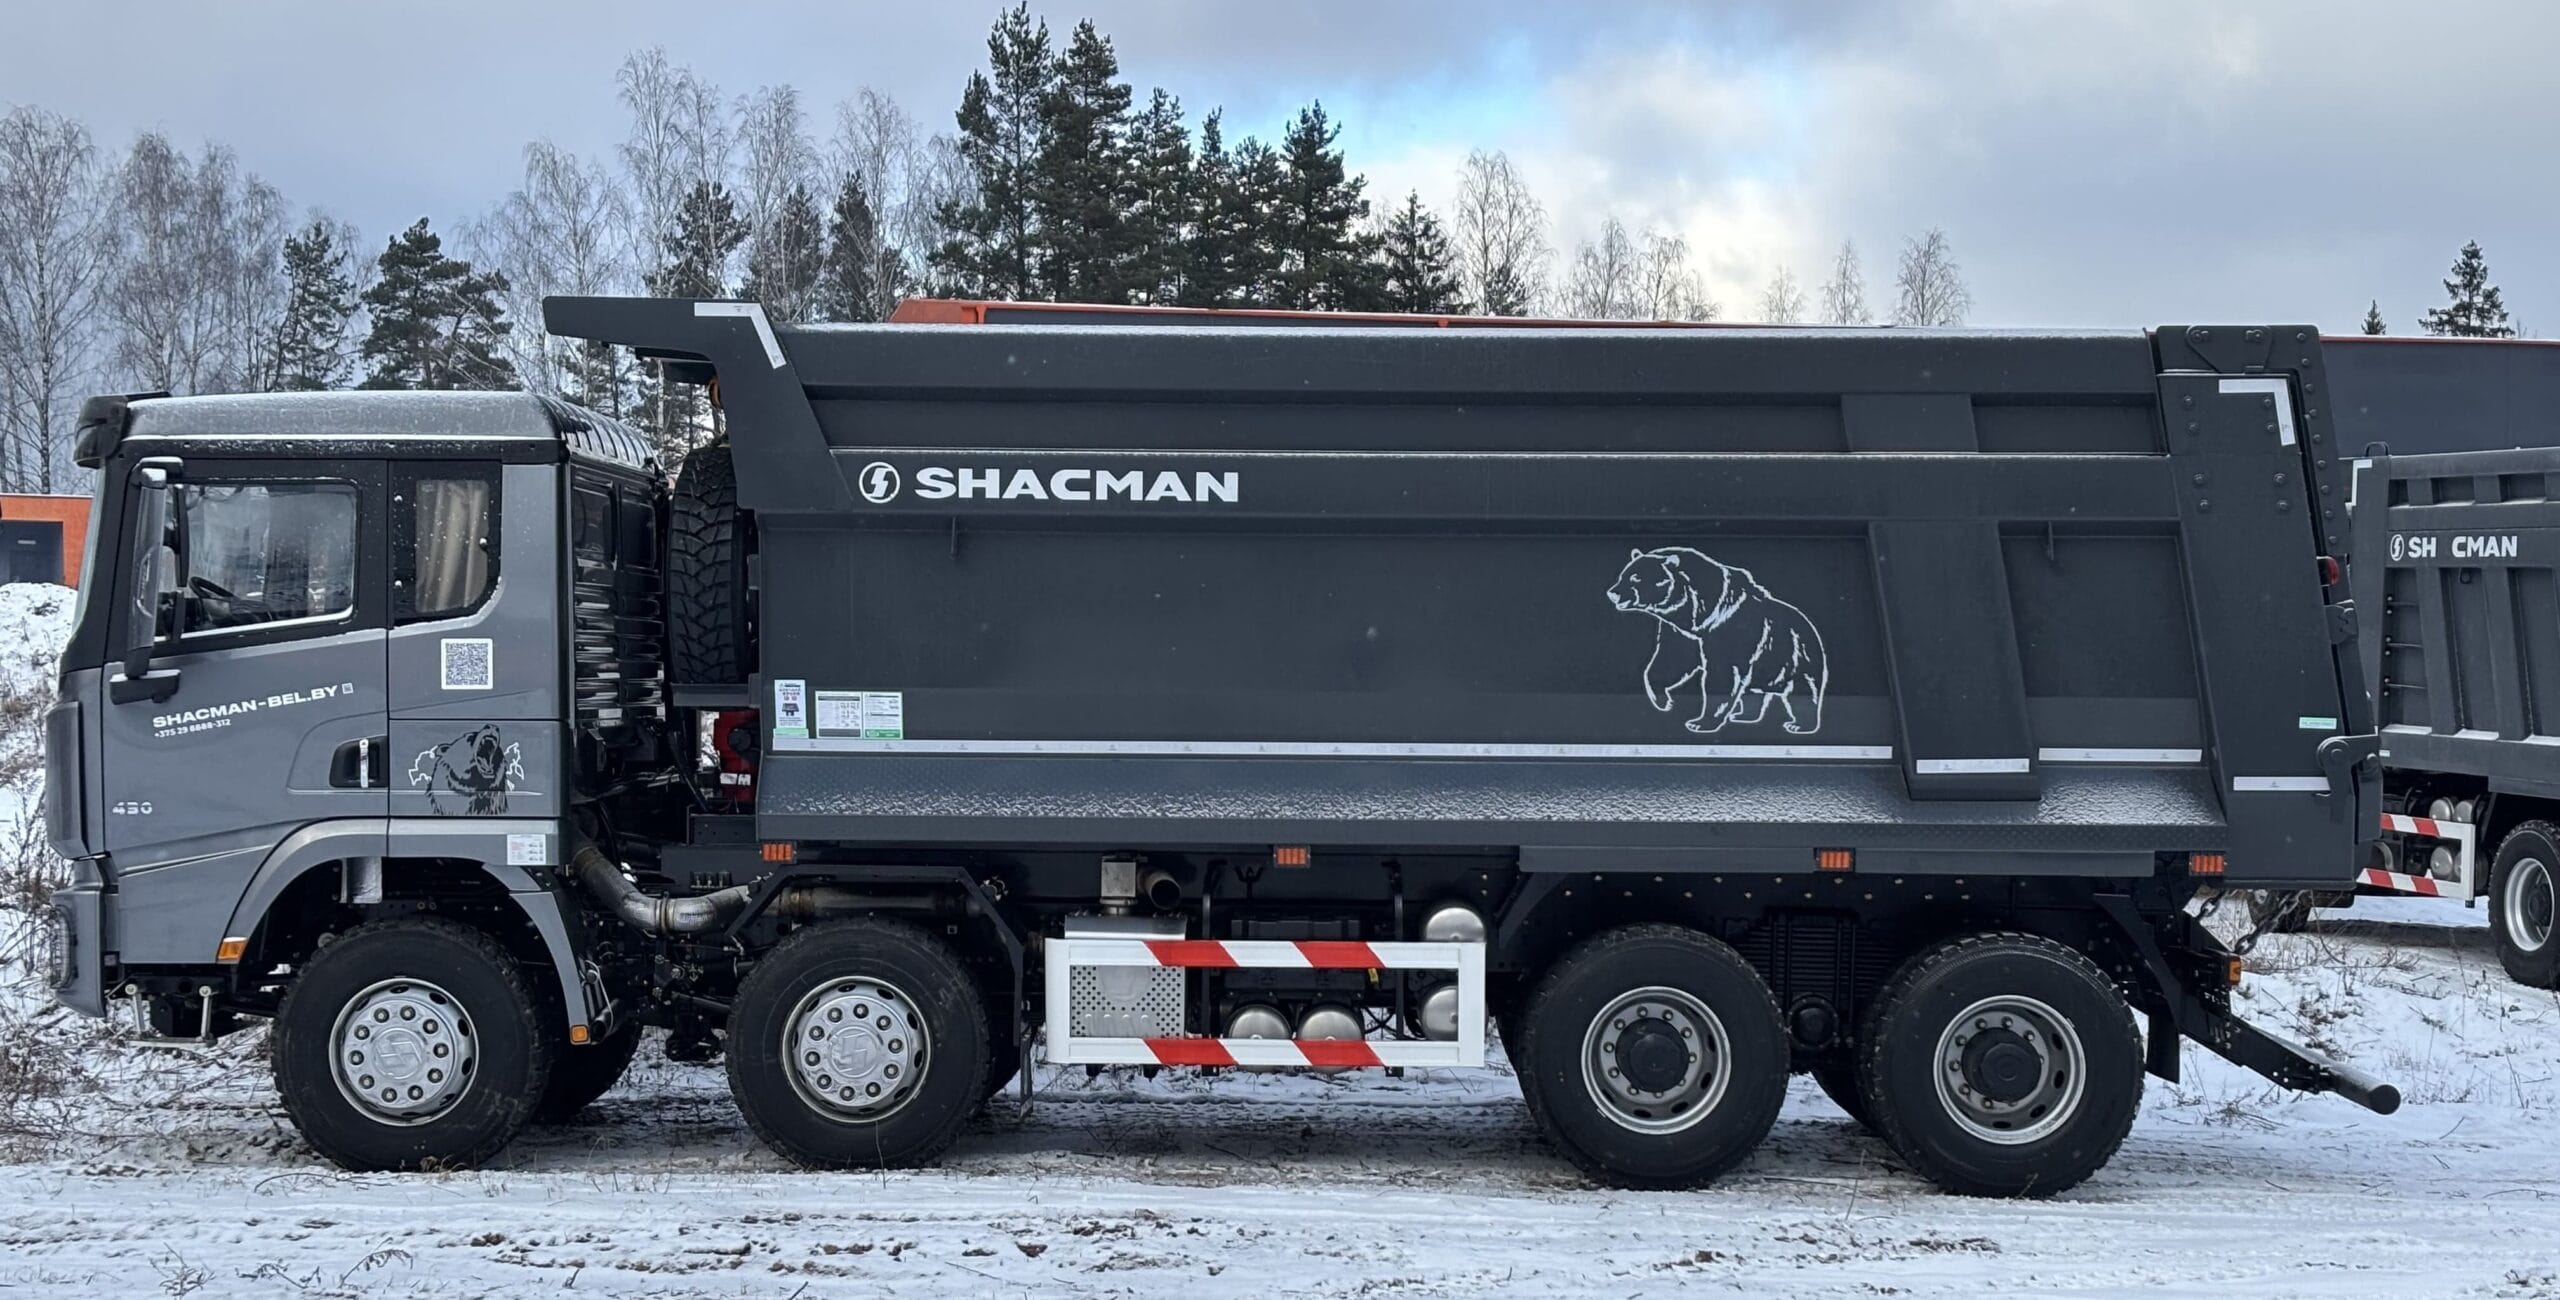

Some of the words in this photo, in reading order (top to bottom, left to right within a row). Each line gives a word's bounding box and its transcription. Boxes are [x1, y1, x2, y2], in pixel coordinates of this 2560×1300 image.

[914, 467, 1239, 503] SHACMAN
[153, 685, 338, 728] SHACMAN-BEL.BY
[154, 728, 177, 738] +375
[177, 726, 188, 735] 29
